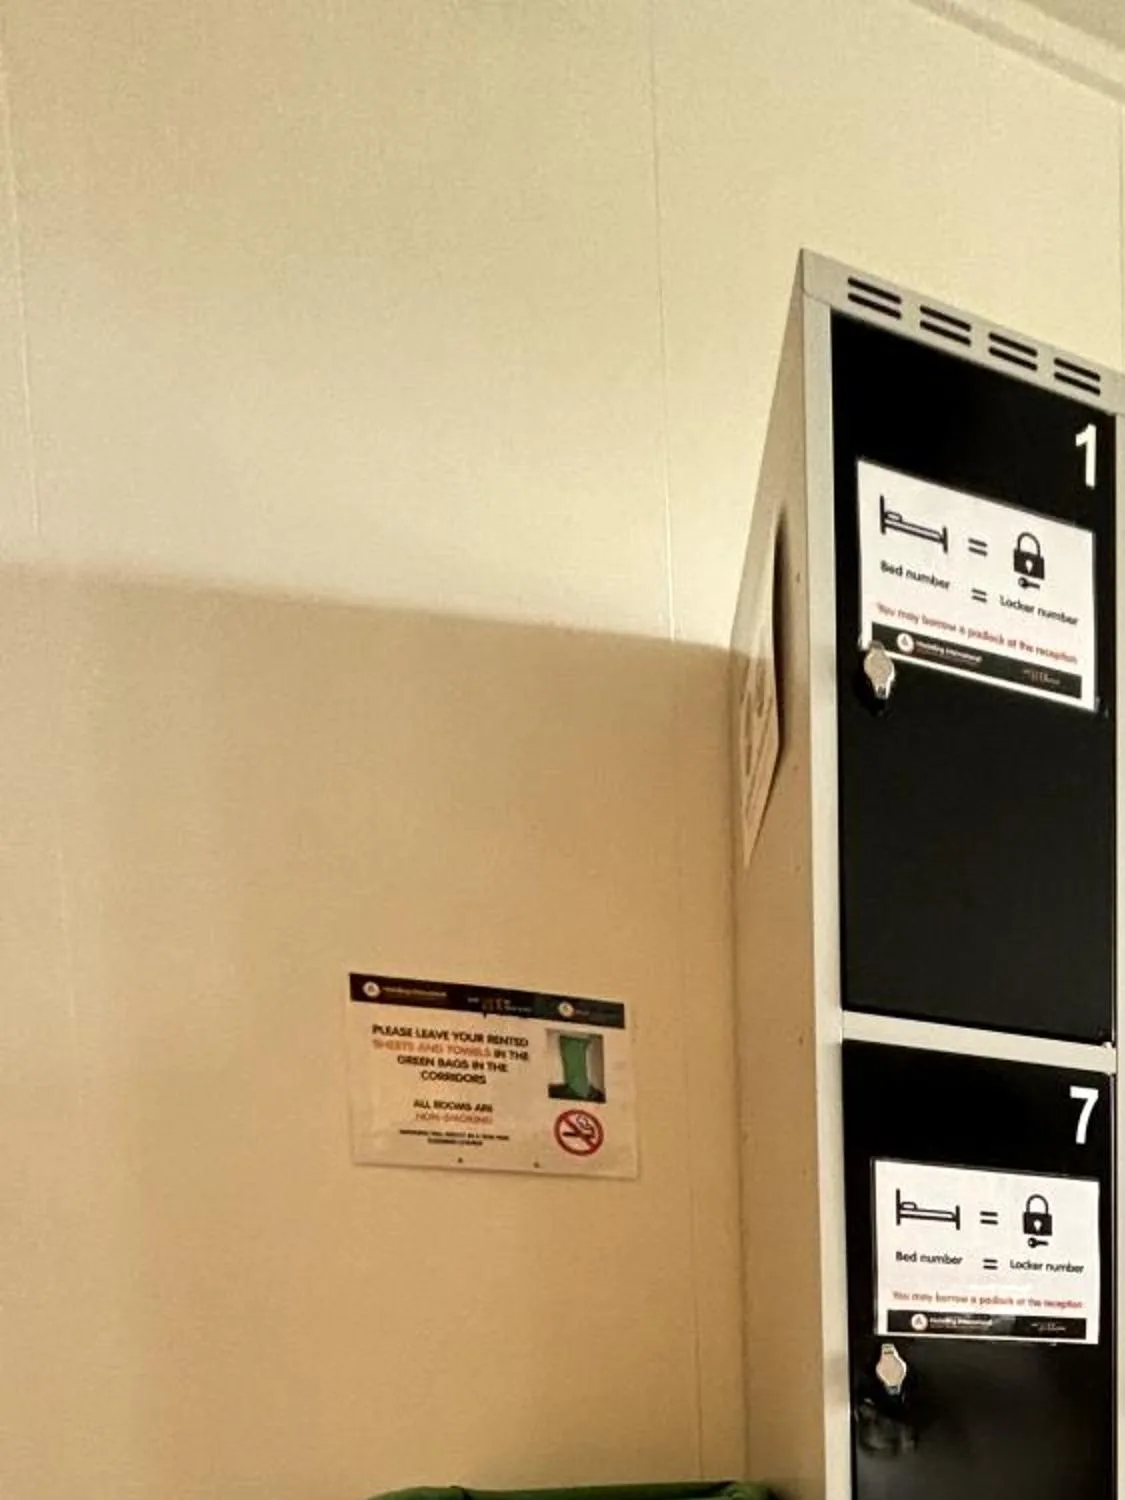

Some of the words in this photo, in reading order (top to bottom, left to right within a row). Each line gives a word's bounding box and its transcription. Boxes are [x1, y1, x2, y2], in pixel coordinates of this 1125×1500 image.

[1075, 423, 1097, 488] 1
[880, 560, 902, 578] Bed
[906, 568, 949, 591] number
[999, 594, 1033, 615] Locker
[1037, 606, 1078, 627] number
[372, 1024, 412, 1037] PLEASE
[416, 1028, 449, 1040] LEAVE
[452, 1031, 484, 1044] YOUR
[397, 1054, 434, 1067] GREEN
[472, 1060, 484, 1071] IN
[487, 1061, 508, 1073] THE
[508, 1049, 529, 1062] THE
[1069, 1085, 1099, 1144] 7
[895, 1251, 917, 1263] Bed
[920, 1253, 962, 1265] number
[1009, 1258, 1041, 1270] Locker
[1045, 1261, 1084, 1273] number
